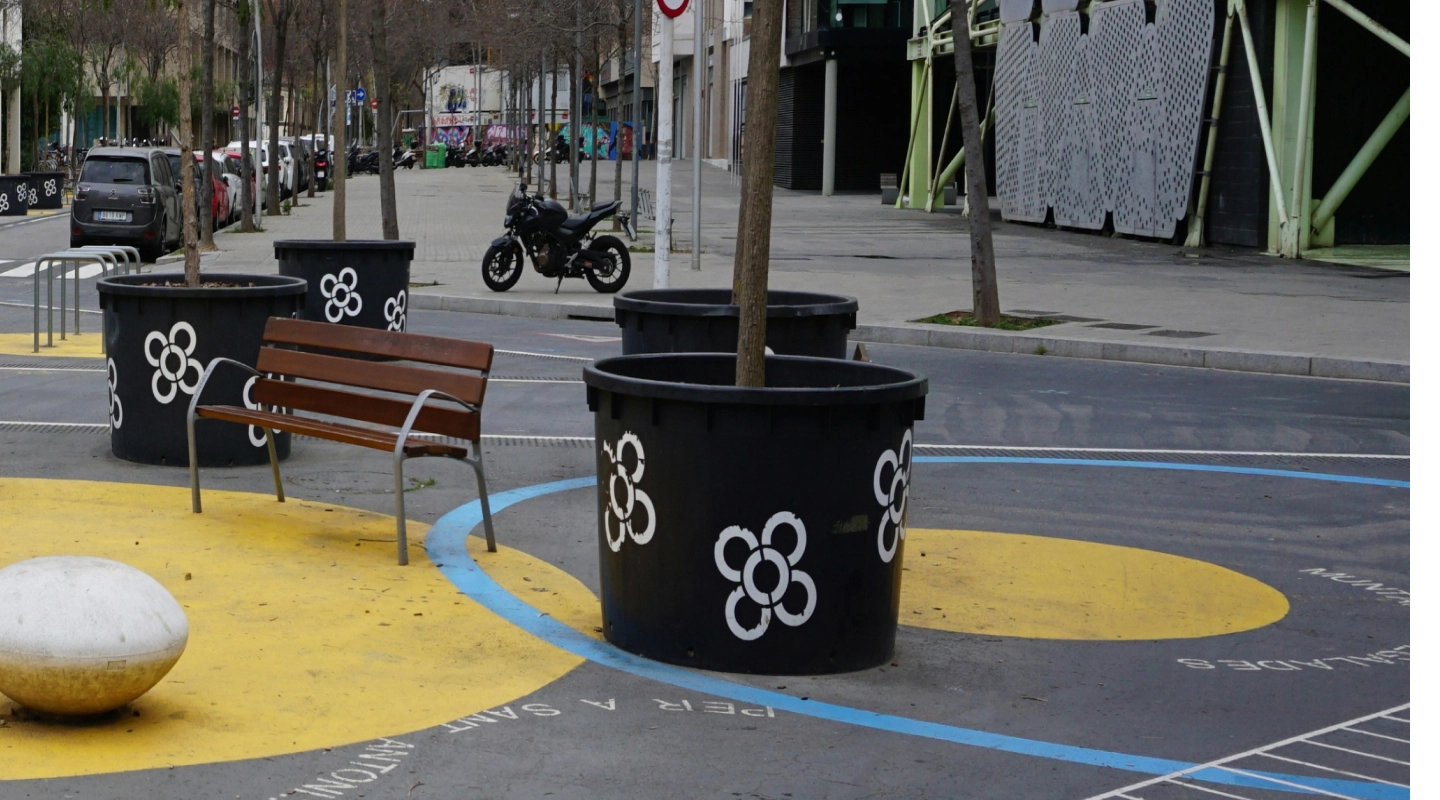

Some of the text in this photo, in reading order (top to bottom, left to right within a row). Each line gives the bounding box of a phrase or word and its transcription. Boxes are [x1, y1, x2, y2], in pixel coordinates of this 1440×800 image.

[579, 697, 616, 711] A
[652, 698, 775, 718] PER
[440, 702, 562, 734] SANT
